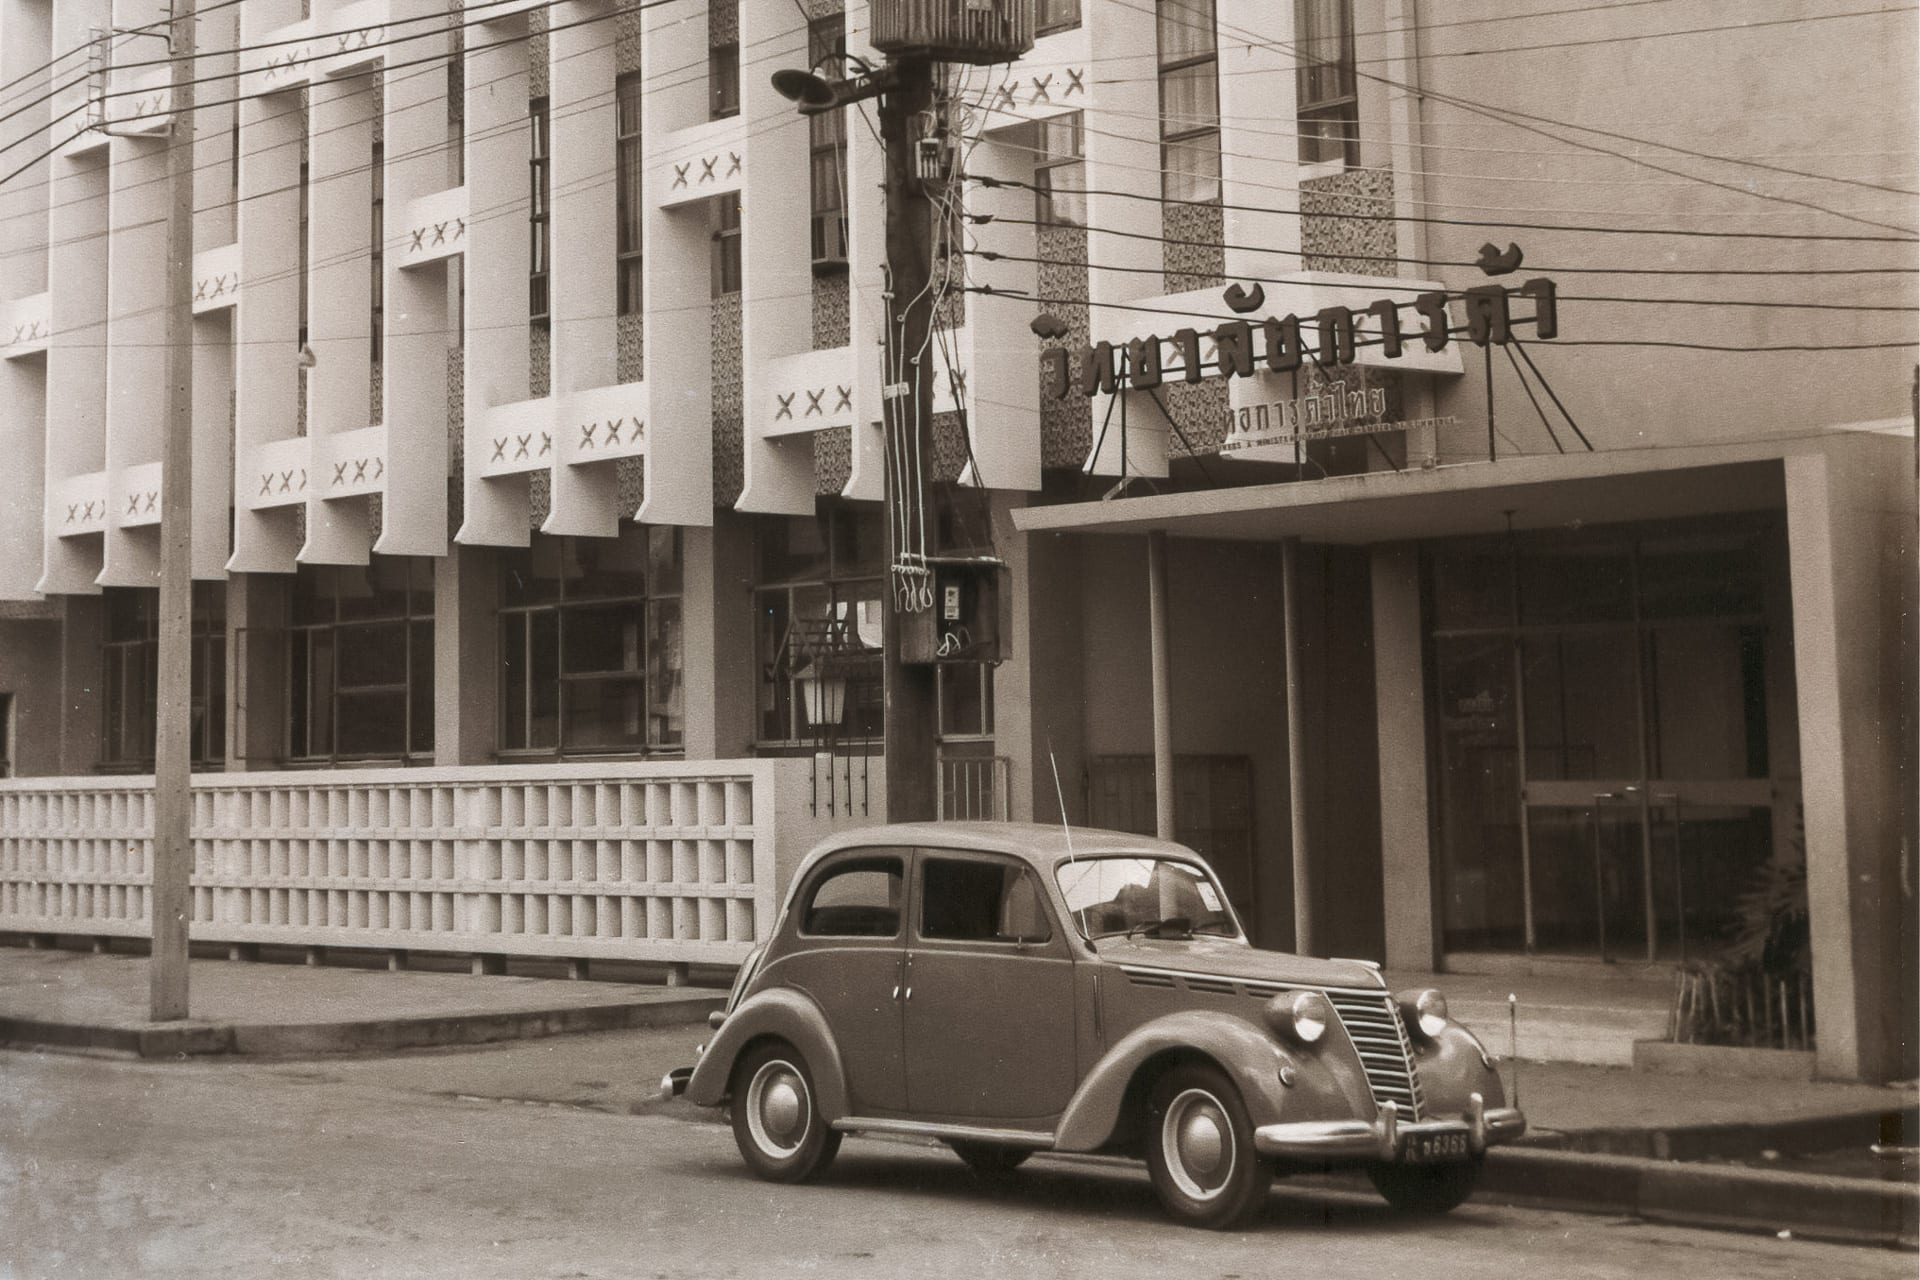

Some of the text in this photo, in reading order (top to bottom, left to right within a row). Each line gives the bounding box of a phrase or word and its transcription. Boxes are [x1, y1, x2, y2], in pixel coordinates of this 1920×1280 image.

[1030, 242, 1558, 400] วิทยาลัยการค้า
